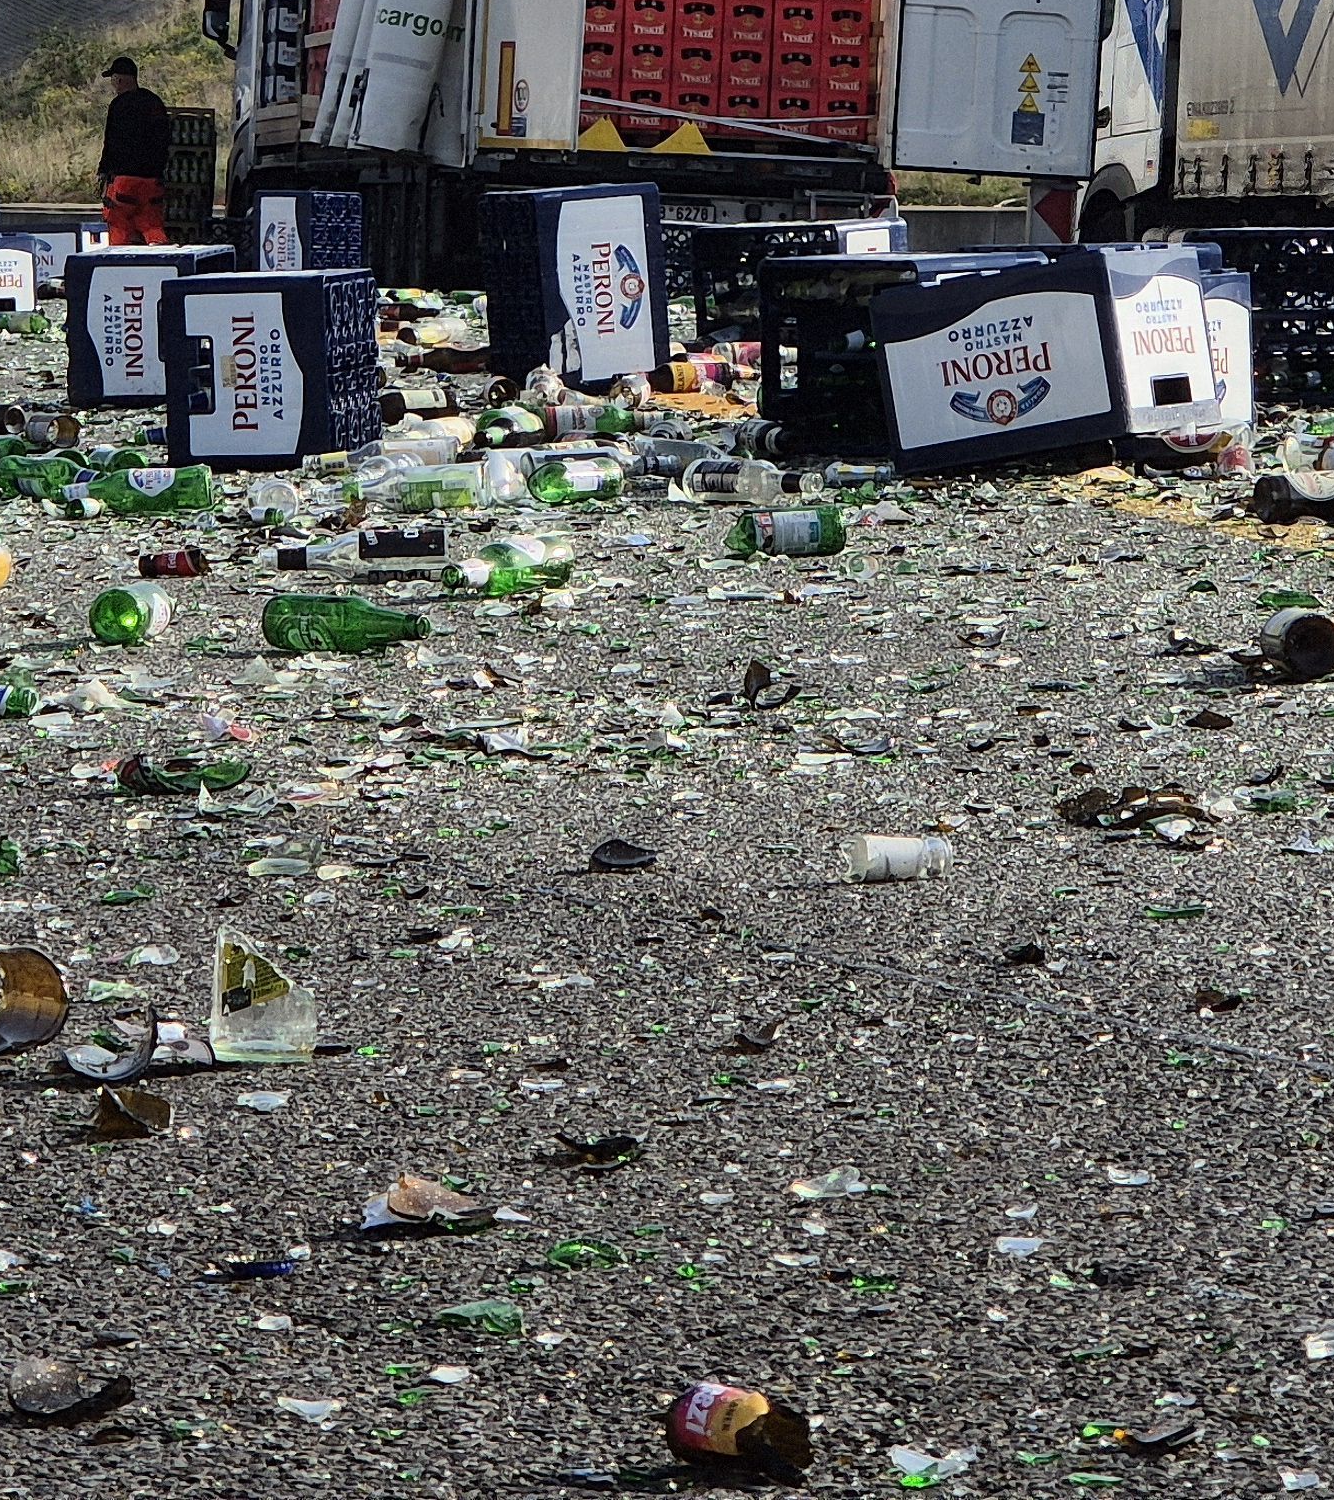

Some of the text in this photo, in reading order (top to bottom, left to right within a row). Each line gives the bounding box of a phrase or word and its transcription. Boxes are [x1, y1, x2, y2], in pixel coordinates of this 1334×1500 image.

[572, 253, 586, 327] AZZURRO
[591, 243, 615, 335] PERONI
[103, 294, 114, 367] AZZURRO
[123, 286, 144, 378] PERONI
[942, 341, 1052, 387] PERONI
[948, 315, 1033, 343] AZZURRO
[965, 331, 1022, 352] NASTRO
[1132, 326, 1196, 356] PERONI
[231, 315, 259, 431] PERONI
[260, 345, 270, 405] NASTRO
[269, 329, 284, 420] AZZURRO
